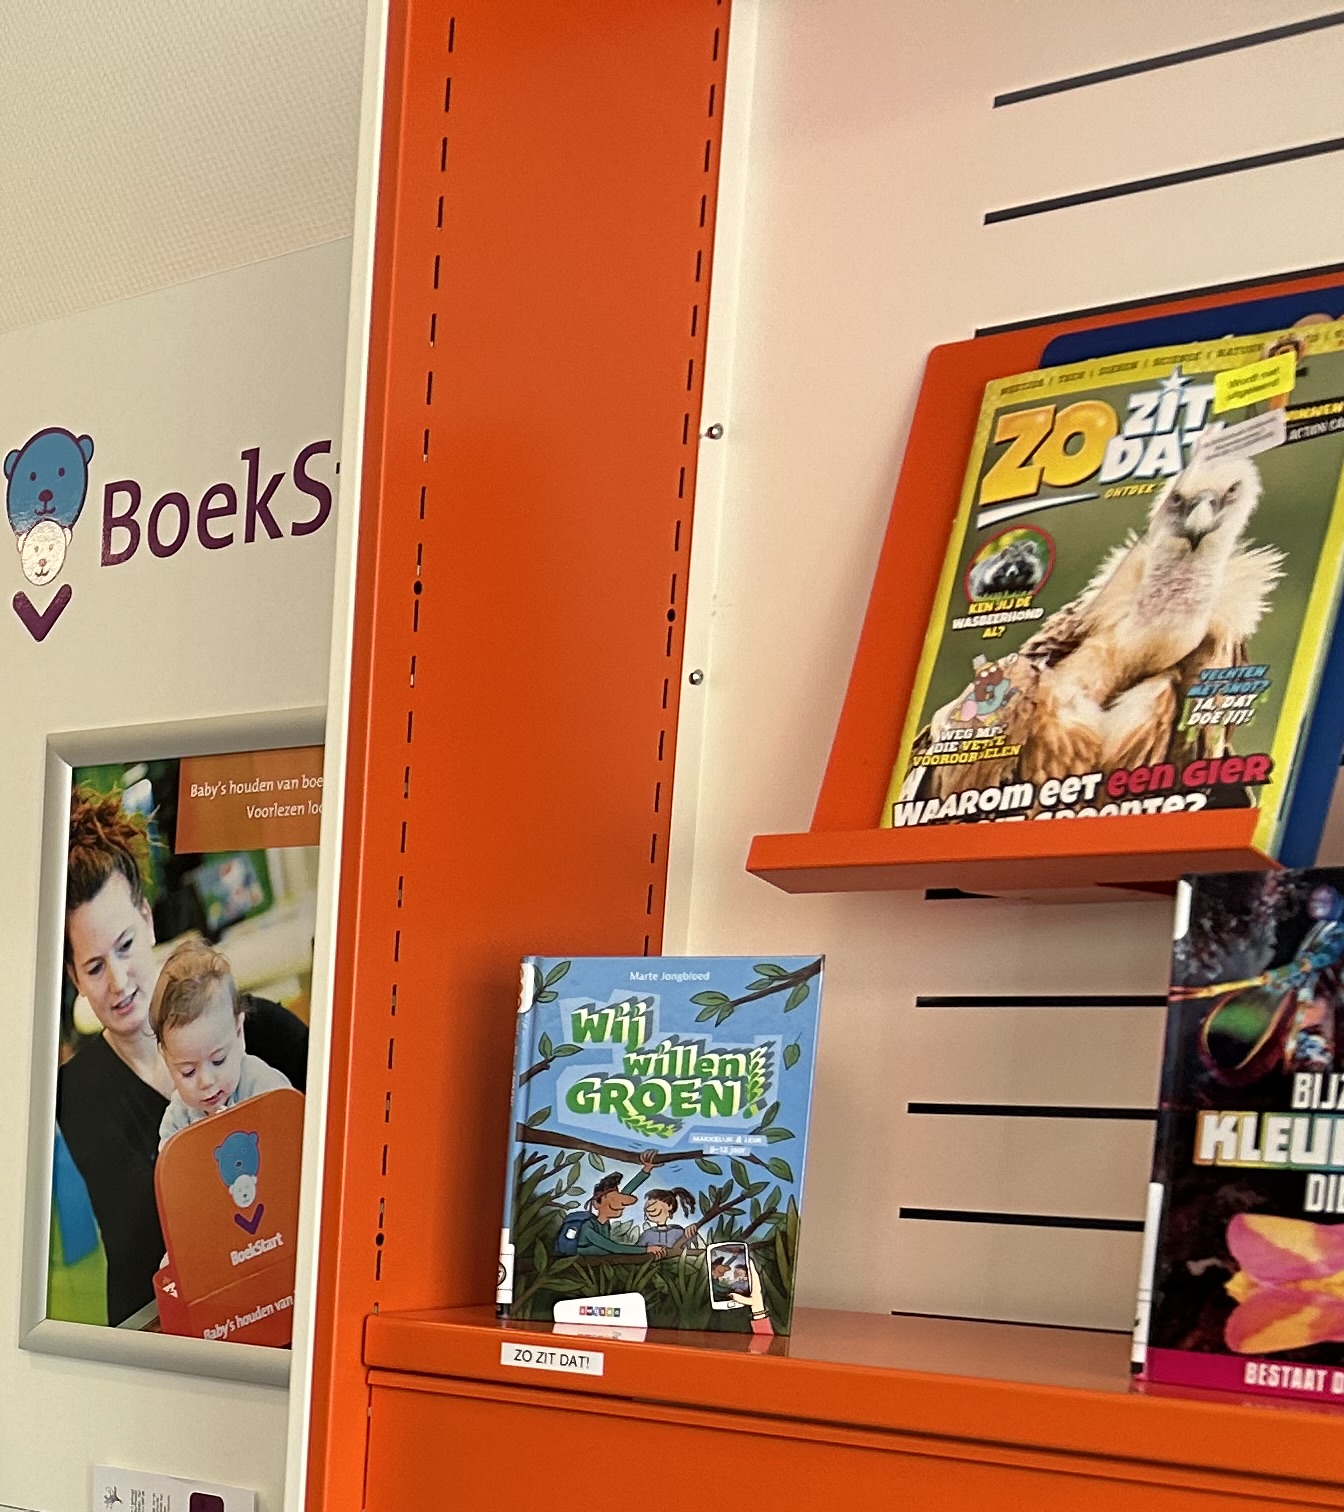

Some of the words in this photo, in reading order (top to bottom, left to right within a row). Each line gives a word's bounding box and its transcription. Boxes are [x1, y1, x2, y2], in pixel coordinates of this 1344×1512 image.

[979, 400, 1119, 505] ZO
[100, 440, 340, 568] BoekS
[968, 600, 995, 614] KEN
[1015, 596, 1033, 608] DE
[983, 625, 1006, 639] AL?
[1200, 665, 1270, 681] VECHTEN
[1220, 694, 1258, 709] DAT
[1187, 711, 1222, 726] DOE
[940, 728, 974, 742] WEG
[931, 741, 960, 755] DIE
[190, 781, 227, 801] Baby's
[229, 778, 275, 795] houden
[276, 779, 299, 792] van
[246, 803, 305, 819] Voorlezen
[629, 971, 659, 981] Marte
[571, 994, 654, 1053] Wij
[623, 1036, 747, 1080] willen
[1197, 1112, 1344, 1166] KLEU
[230, 1232, 284, 1266] BoekStart
[203, 1318, 236, 1340] Baby's
[234, 1305, 275, 1329] houden
[274, 1295, 294, 1311] van
[514, 1349, 533, 1363] ZO
[535, 1351, 557, 1365] ZIT
[559, 1353, 590, 1370] DAT!
[1244, 1361, 1328, 1393] BESTAAT
